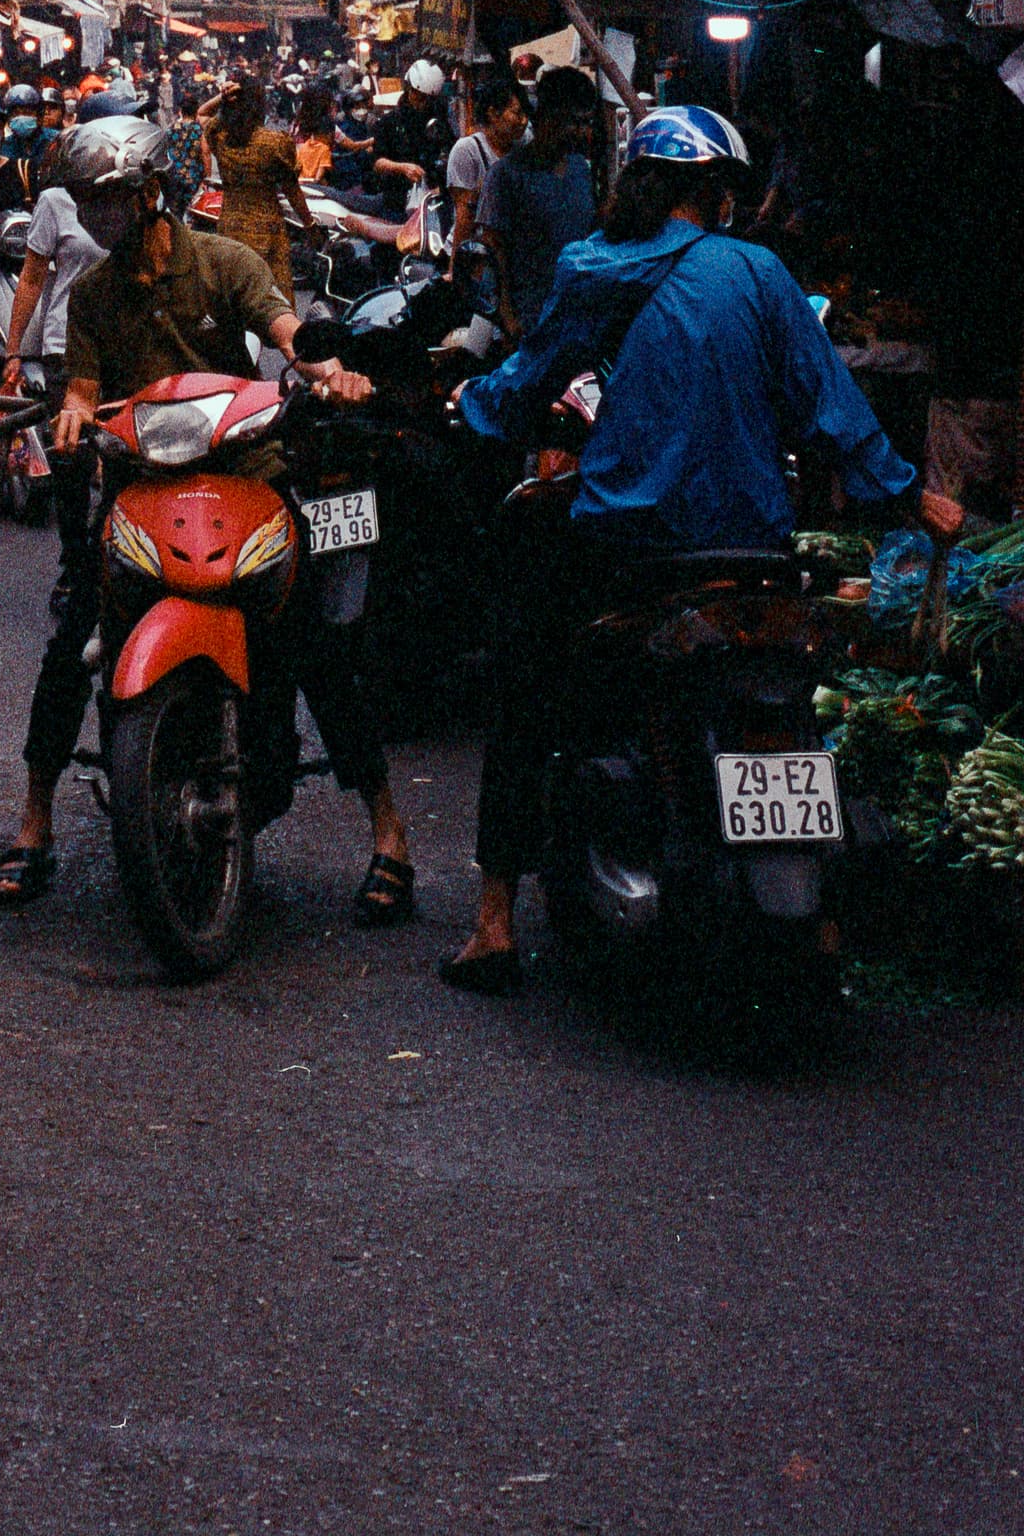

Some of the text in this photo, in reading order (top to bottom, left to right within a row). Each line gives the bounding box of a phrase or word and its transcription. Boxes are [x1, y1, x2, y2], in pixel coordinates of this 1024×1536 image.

[177, 492, 221, 500] HONDA
[311, 495, 364, 526] 29-E2
[734, 760, 819, 795] 29-E2
[729, 800, 834, 836] 630.28
